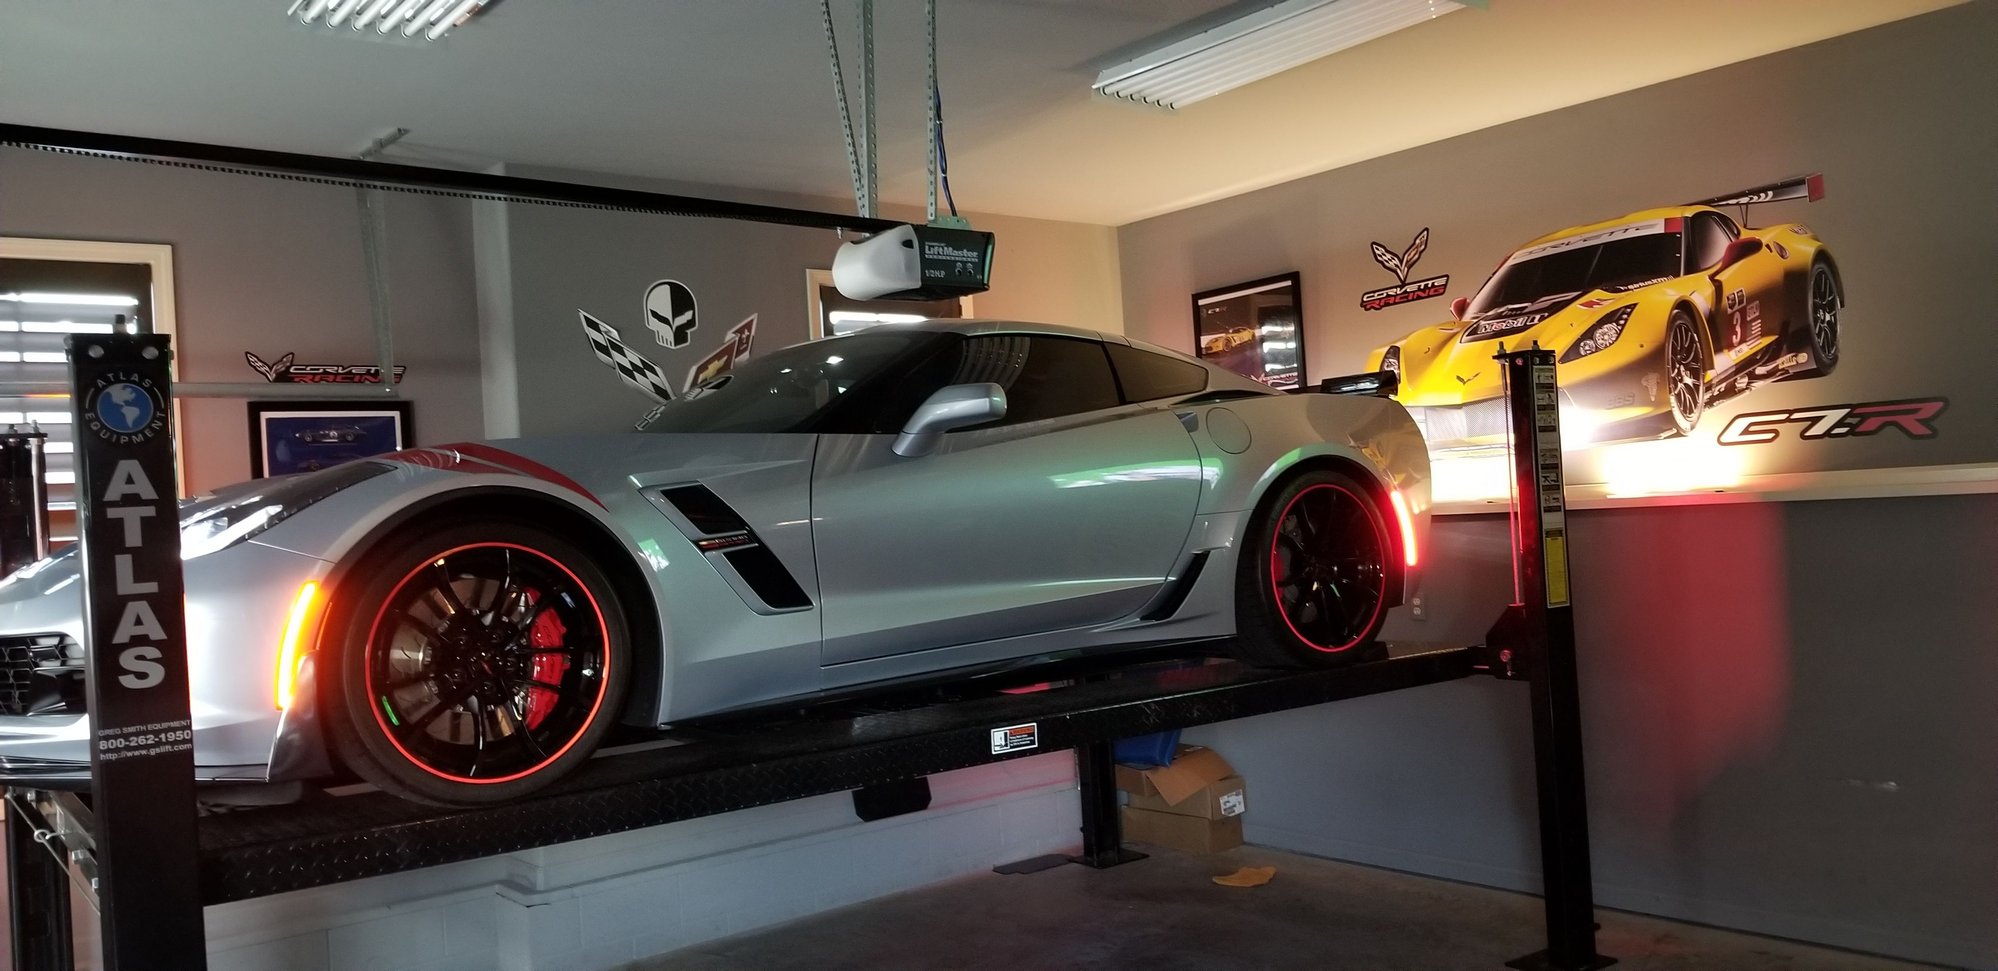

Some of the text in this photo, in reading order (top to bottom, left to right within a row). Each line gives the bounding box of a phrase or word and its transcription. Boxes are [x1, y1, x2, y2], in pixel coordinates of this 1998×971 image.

[925, 245, 979, 258] LiftMaster
[1362, 286, 1446, 309] RACING
[1363, 276, 1448, 302] CORVETTE
[1732, 310, 1742, 347] 3
[96, 371, 153, 389] ATLAS
[289, 365, 406, 375] CORVETE
[84, 410, 166, 445] EQUIPMENT
[102, 459, 168, 690] ATLAS
[122, 724, 147, 734] SMITH
[147, 719, 191, 731] EQUIPMENT
[100, 729, 192, 750] 800-262-1950
[100, 743, 193, 761] http://www.gslift.com
